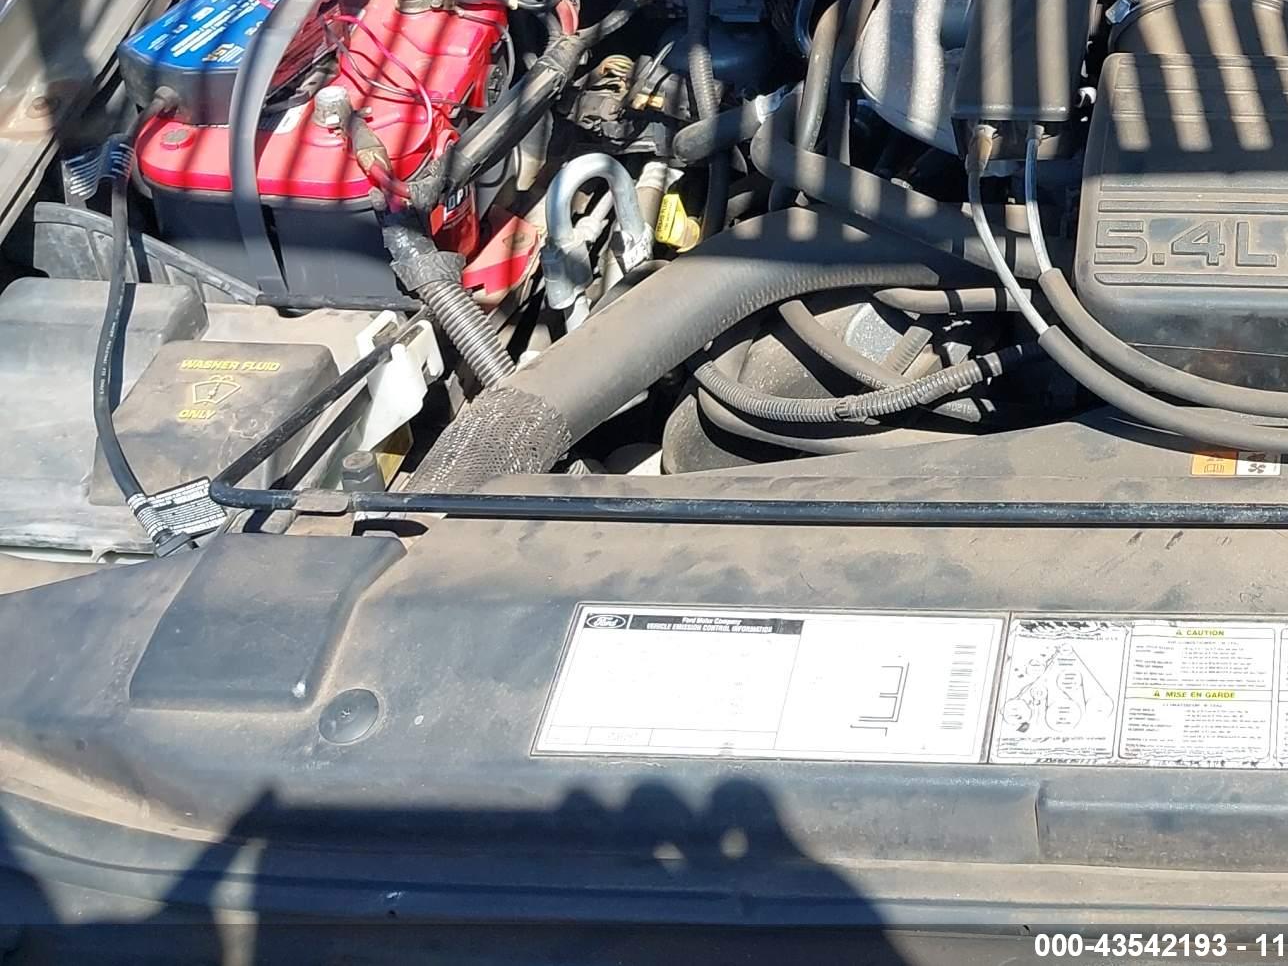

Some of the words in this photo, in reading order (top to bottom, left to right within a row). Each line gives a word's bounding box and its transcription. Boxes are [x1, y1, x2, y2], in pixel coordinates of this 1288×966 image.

[1094, 219, 1278, 268] 5.4L
[181, 359, 240, 371] WASHER
[241, 361, 280, 372] FLUID
[178, 409, 217, 420] ONLY
[593, 615, 619, 628] Ford
